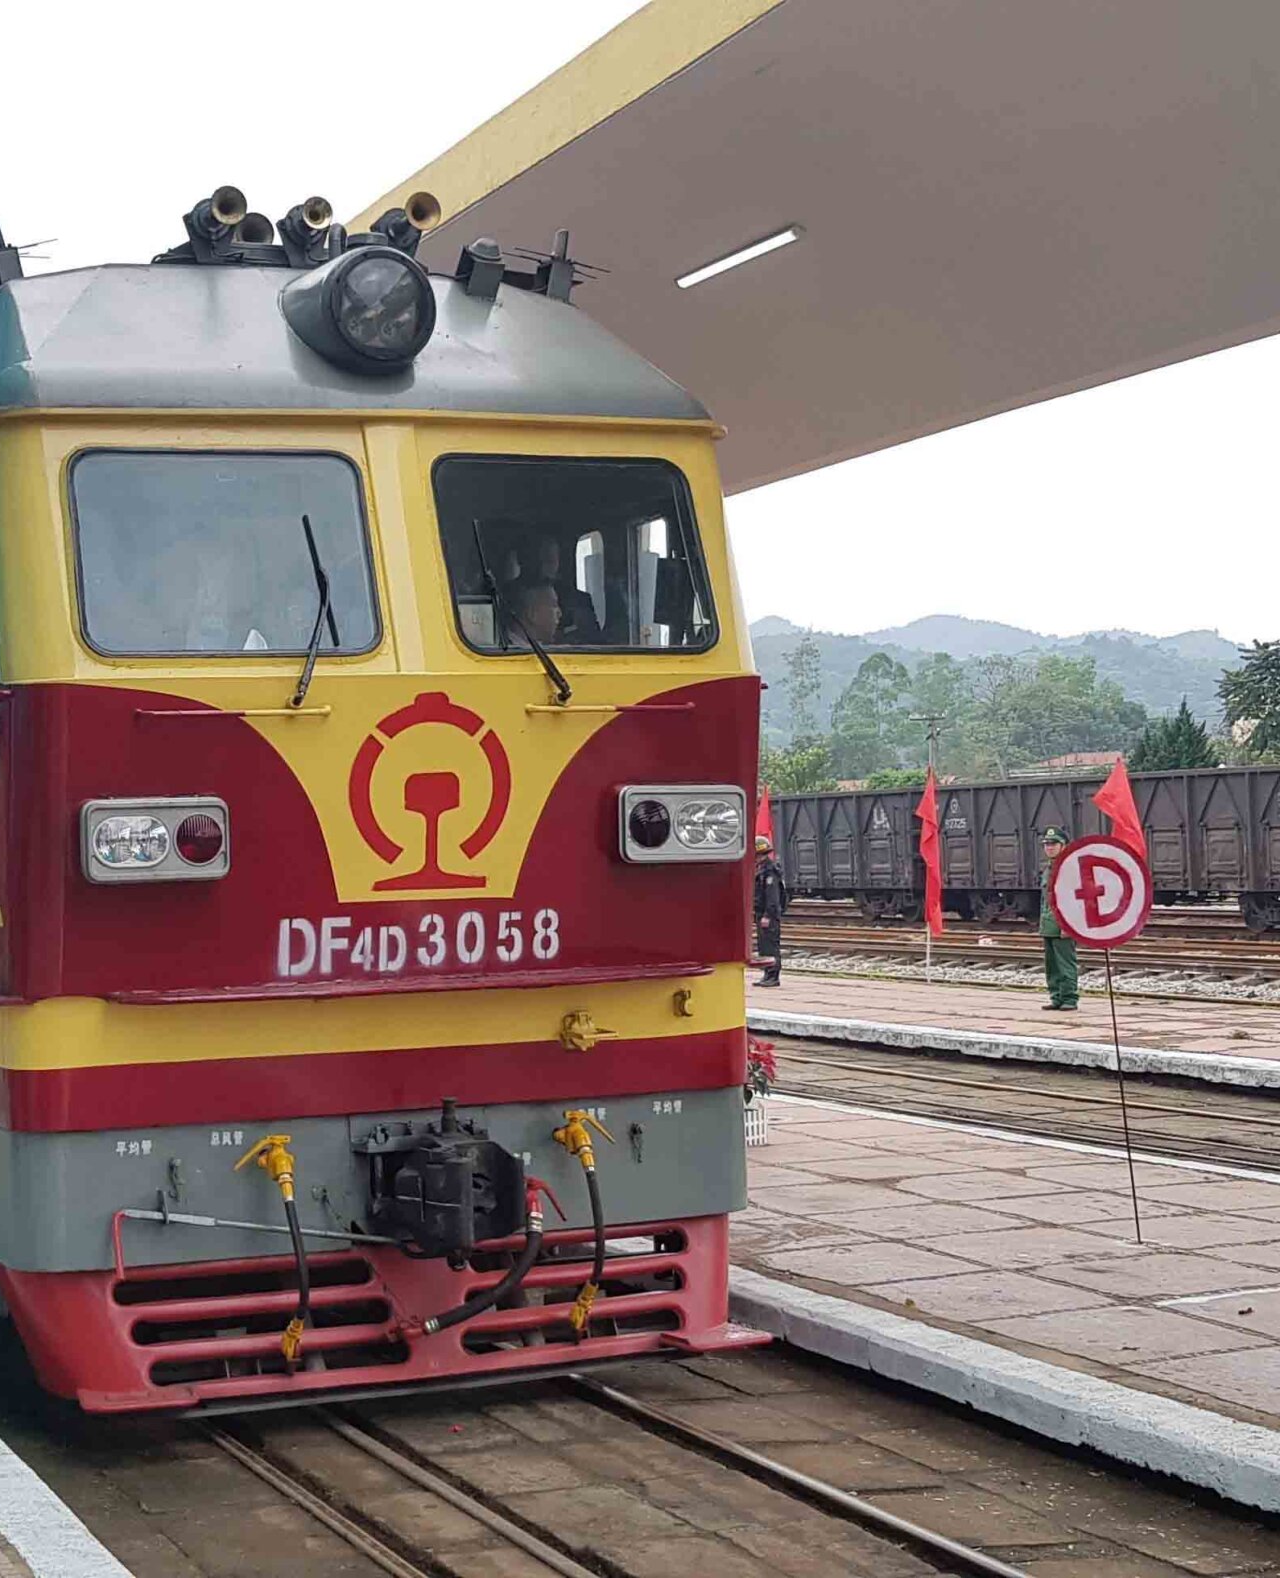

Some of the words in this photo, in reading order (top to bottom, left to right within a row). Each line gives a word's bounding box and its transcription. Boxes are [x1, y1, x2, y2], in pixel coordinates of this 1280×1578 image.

[1074, 854, 1133, 929] Đ
[115, 1140, 153, 1156] 平均管
